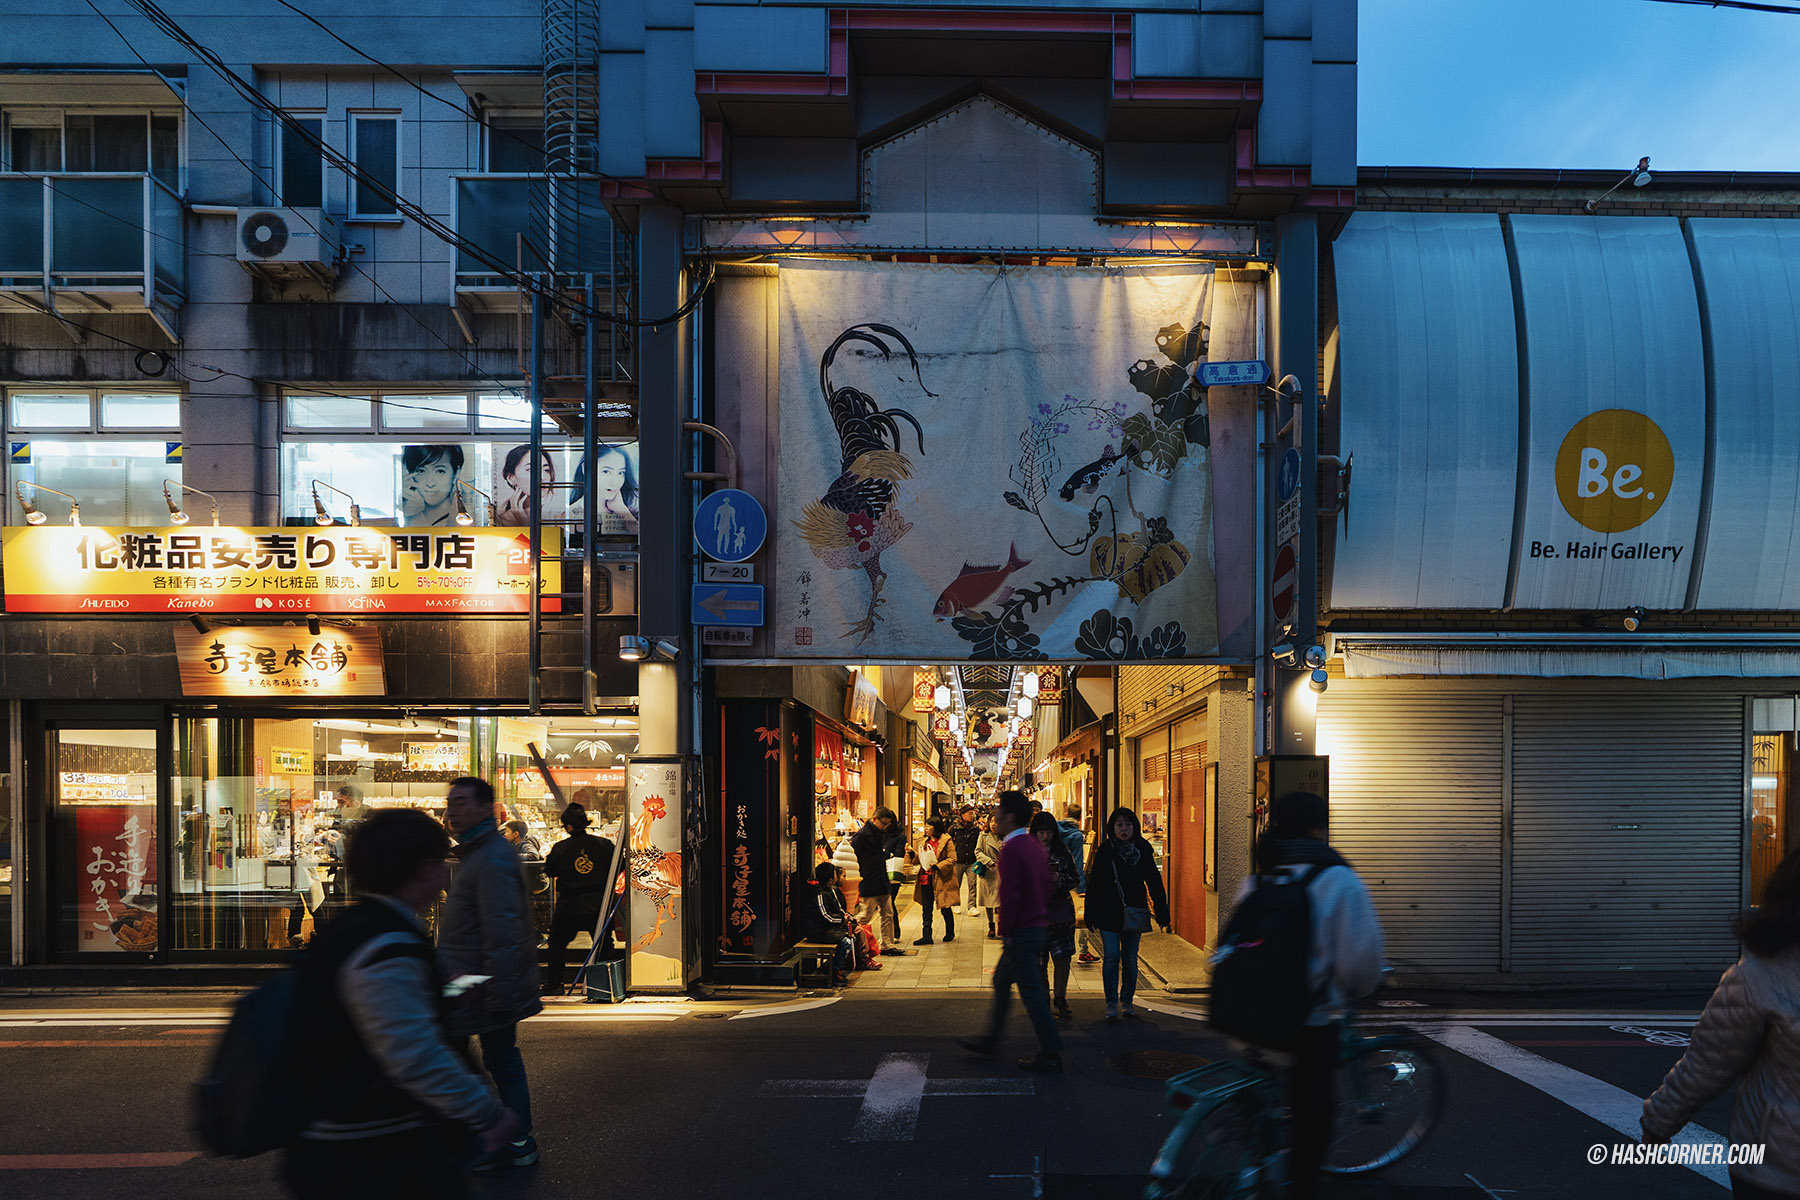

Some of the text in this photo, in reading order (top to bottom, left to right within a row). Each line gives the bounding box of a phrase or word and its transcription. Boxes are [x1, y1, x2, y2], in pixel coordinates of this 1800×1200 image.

[1209, 363, 1258, 377] 高倉通
[1214, 374, 1254, 383] Takakura-dori
[1577, 447, 1655, 500] Be.
[76, 533, 476, 570] 化粧品安売り専門店
[1530, 541, 1684, 562] Be. Hair Gallery
[152, 575, 319, 590] 各種有名ブランド化粧品
[79, 598, 130, 608] SHISEIDO
[167, 597, 215, 609] Kanebo
[278, 597, 311, 609] KOSÉ
[115, 815, 148, 895] 手造り
[86, 845, 119, 932] おかき
